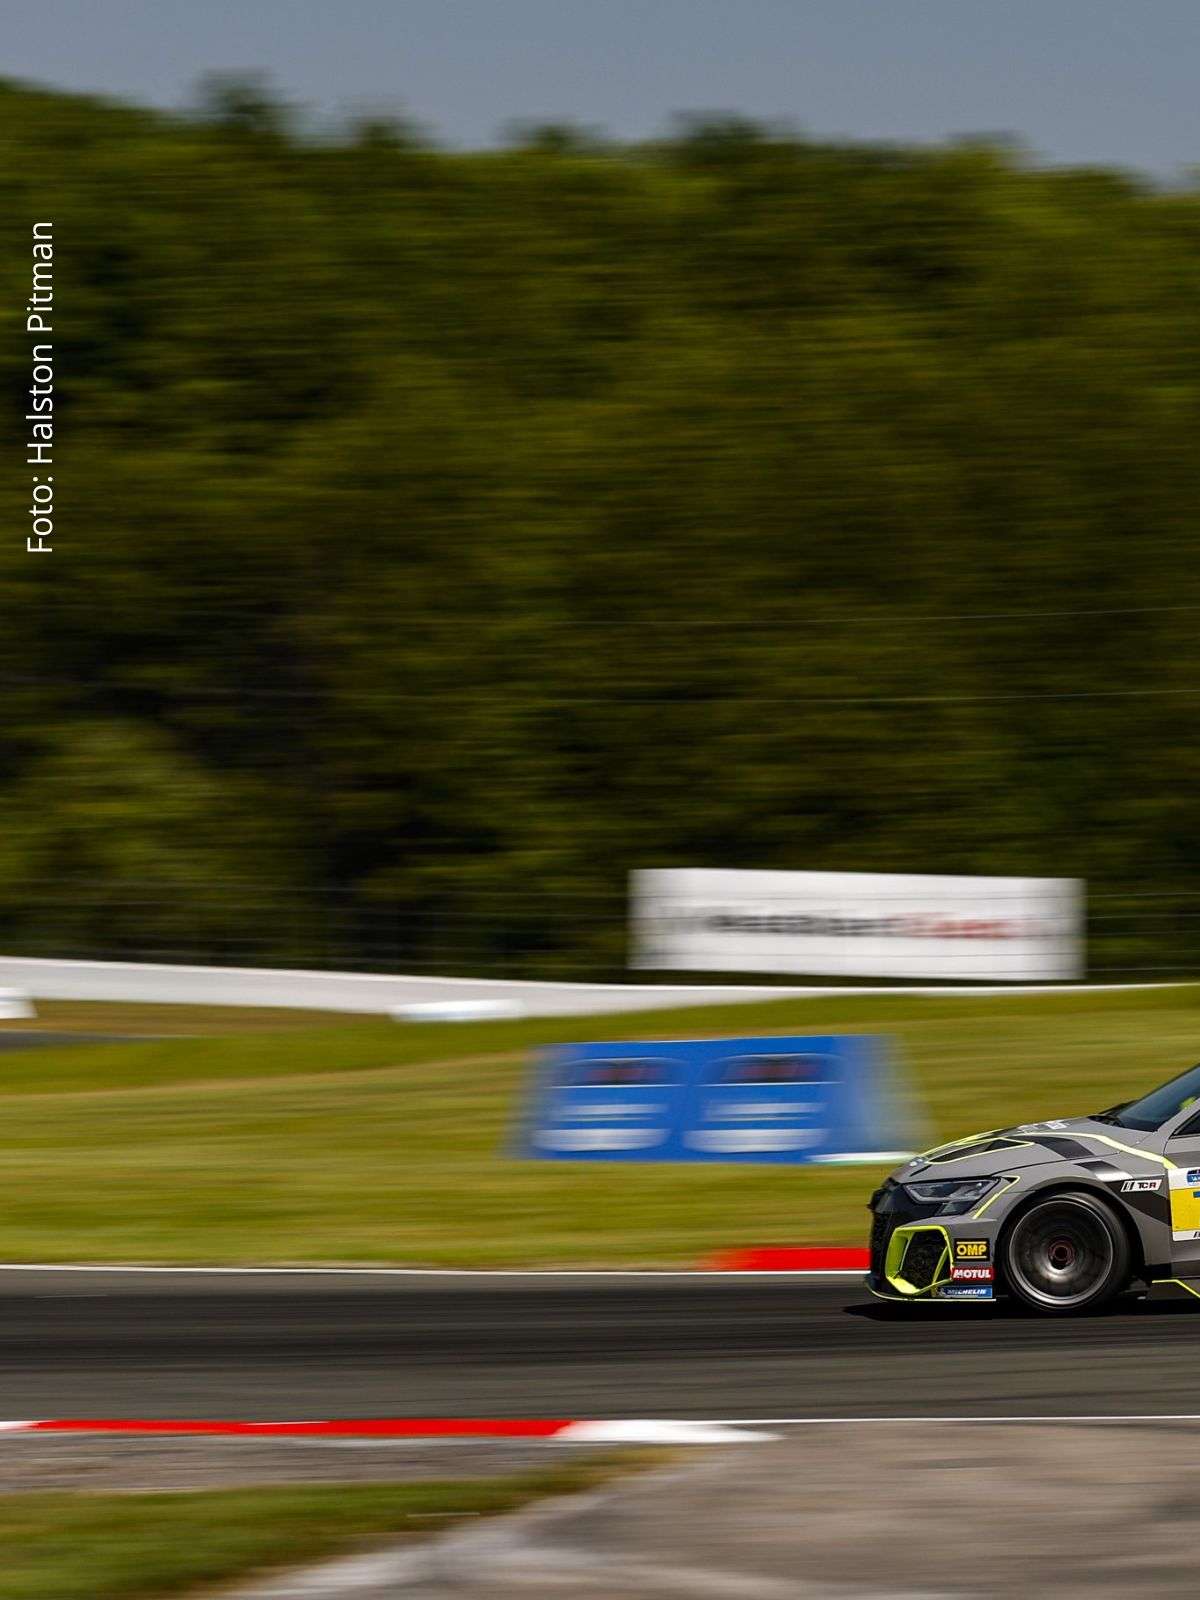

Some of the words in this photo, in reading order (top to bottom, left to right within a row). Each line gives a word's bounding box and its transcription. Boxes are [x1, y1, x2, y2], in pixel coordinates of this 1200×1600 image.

[1137, 1180, 1157, 1189] TCR
[956, 1244, 987, 1256] OMP
[953, 1269, 992, 1279] MOTUL
